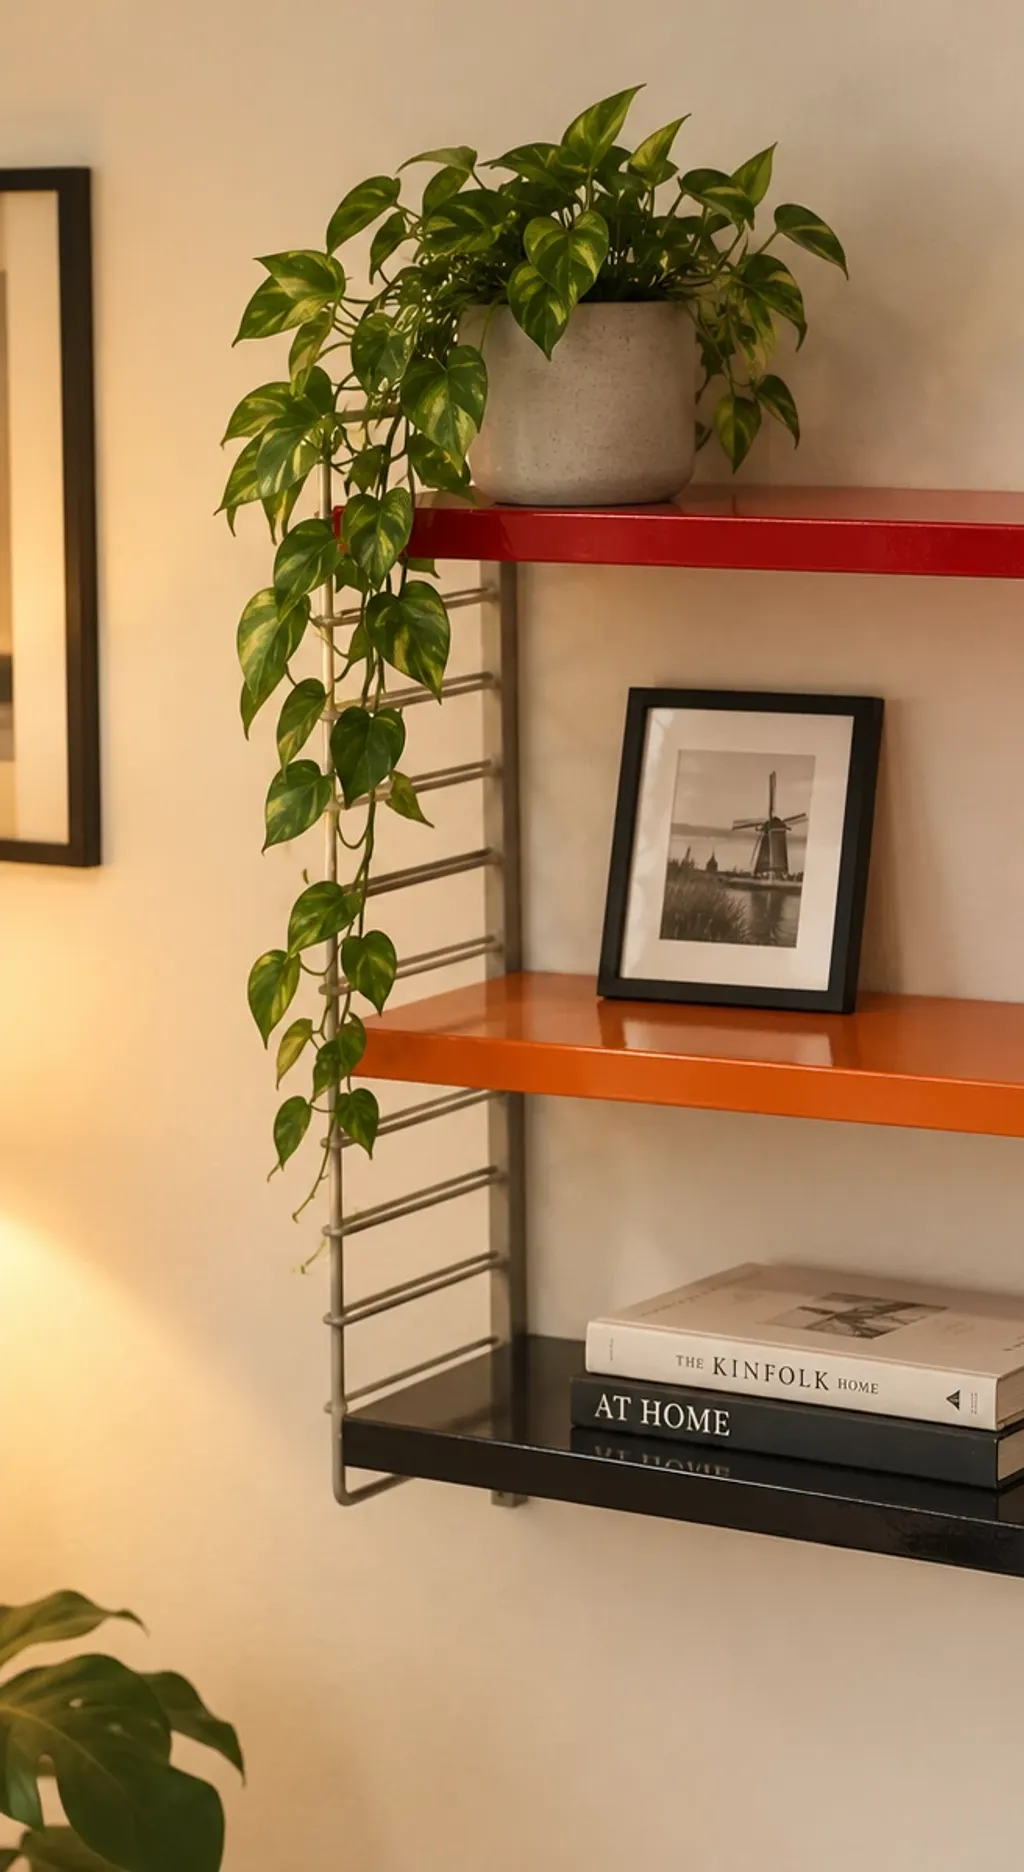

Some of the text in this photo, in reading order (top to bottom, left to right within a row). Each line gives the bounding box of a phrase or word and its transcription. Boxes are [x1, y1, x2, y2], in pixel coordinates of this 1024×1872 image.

[675, 1354, 879, 1395] THE KINFOLK HOME
[594, 1393, 731, 1437] AT HOME
